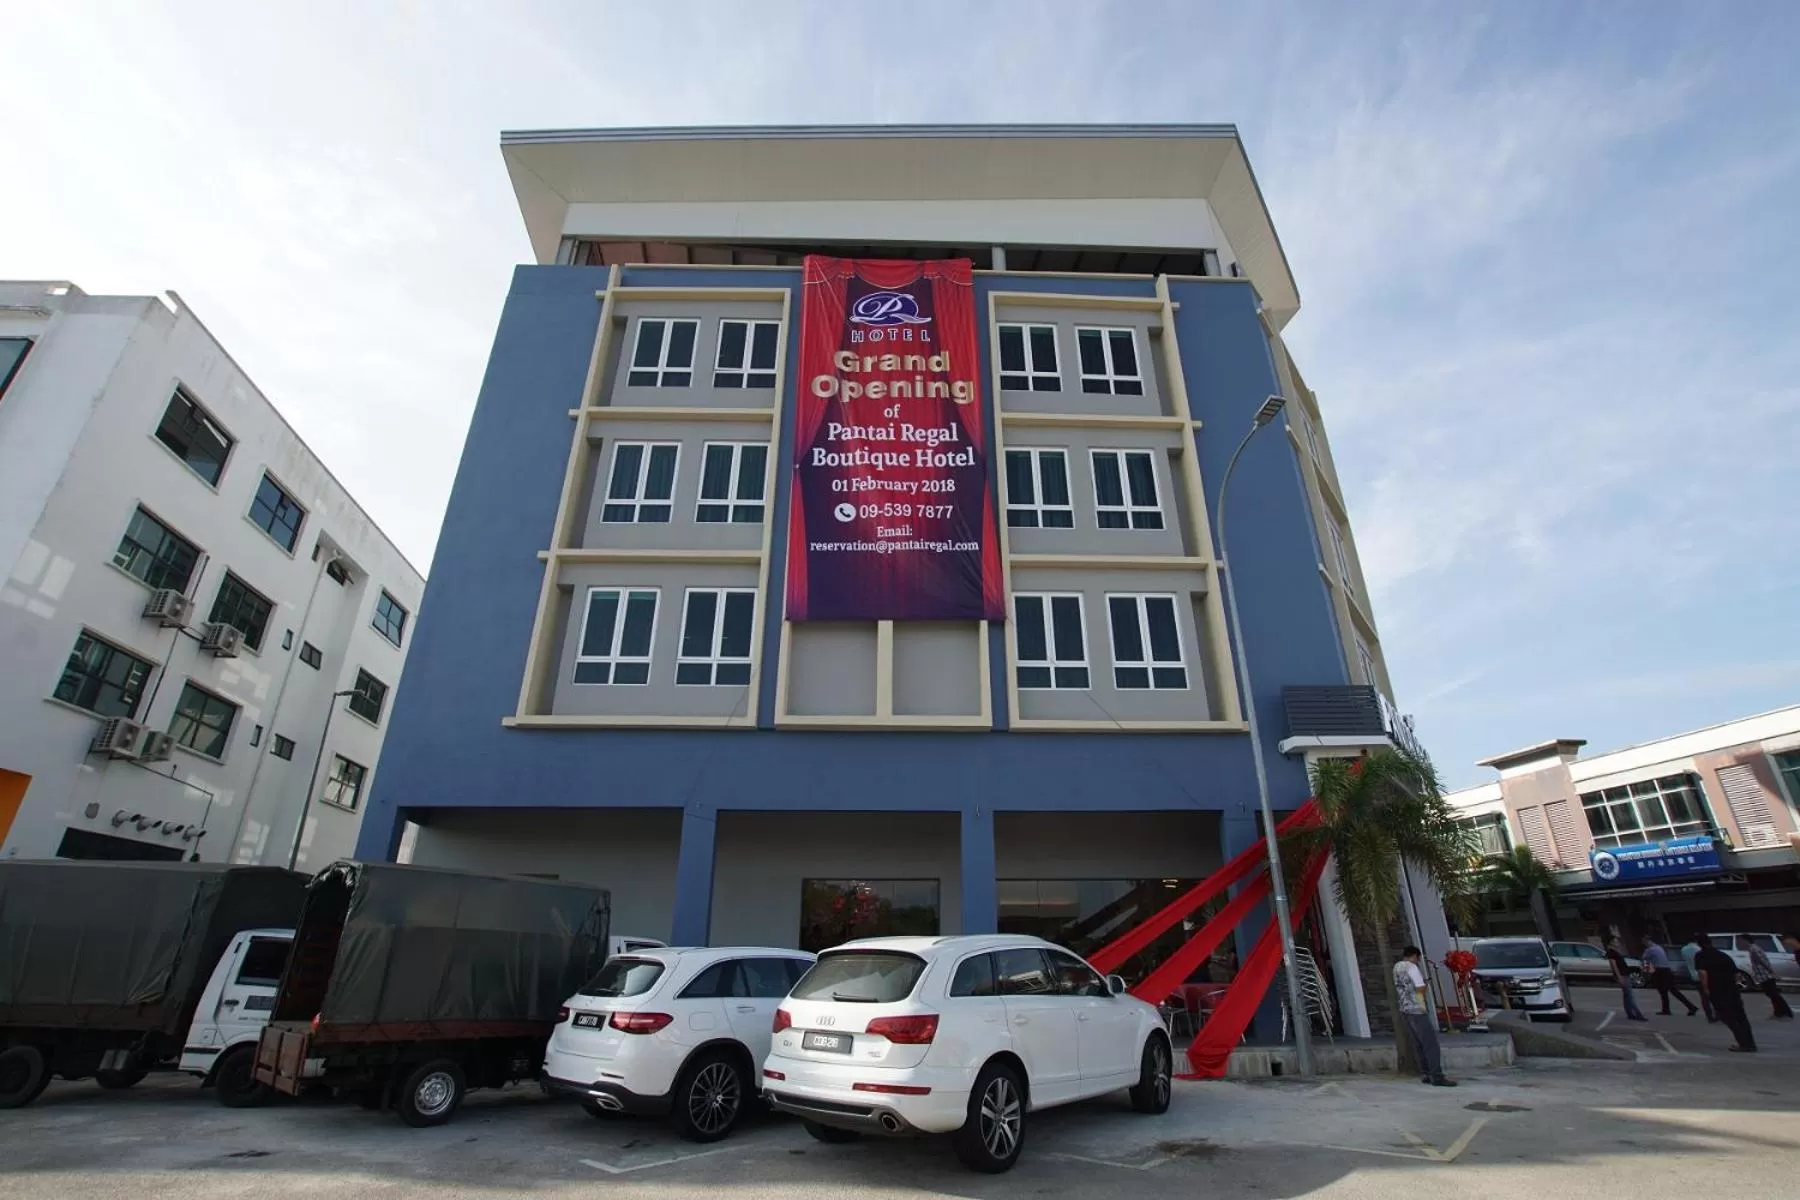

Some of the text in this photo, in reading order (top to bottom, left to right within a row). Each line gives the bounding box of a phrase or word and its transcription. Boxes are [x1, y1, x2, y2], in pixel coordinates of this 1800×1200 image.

[851, 328, 931, 343] HOTEL
[833, 350, 950, 373] Grand
[811, 374, 974, 404] Opening
[884, 404, 900, 418] of
[827, 422, 959, 446] Pantai Regal
[812, 447, 976, 471] Boutique Hotel
[832, 476, 956, 495] 01 February 2018
[859, 503, 954, 519] 09-539 7877
[877, 525, 913, 538] Email:
[810, 538, 980, 553] reservation@pantairegal.com
